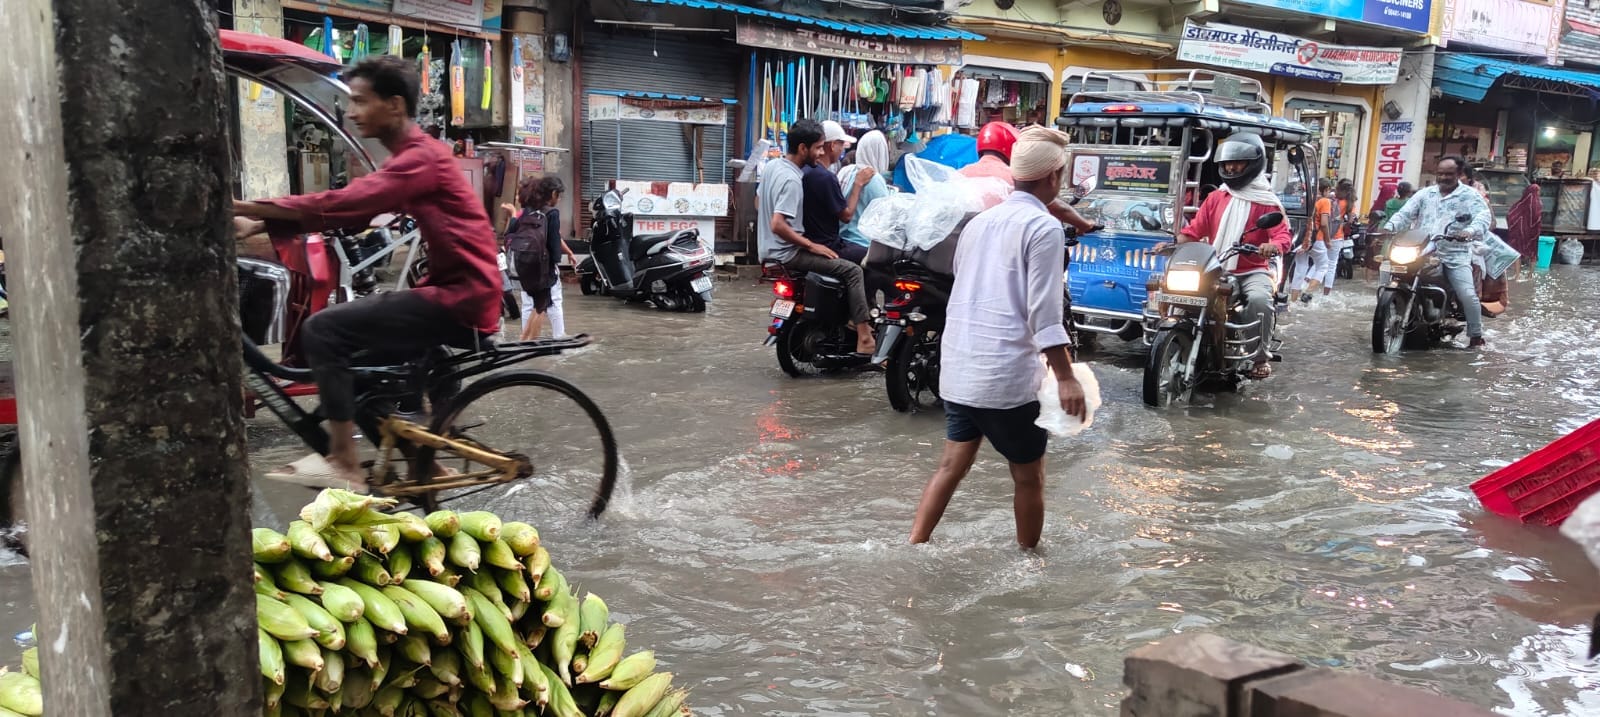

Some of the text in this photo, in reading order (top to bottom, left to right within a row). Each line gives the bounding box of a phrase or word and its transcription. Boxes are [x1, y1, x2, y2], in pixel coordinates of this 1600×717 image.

[1377, 0, 1424, 10] ICINERS
[1381, 121, 1413, 133] डायमण्ड
[636, 221, 665, 231] THE
[1082, 263, 1139, 277] BULLDOZER
